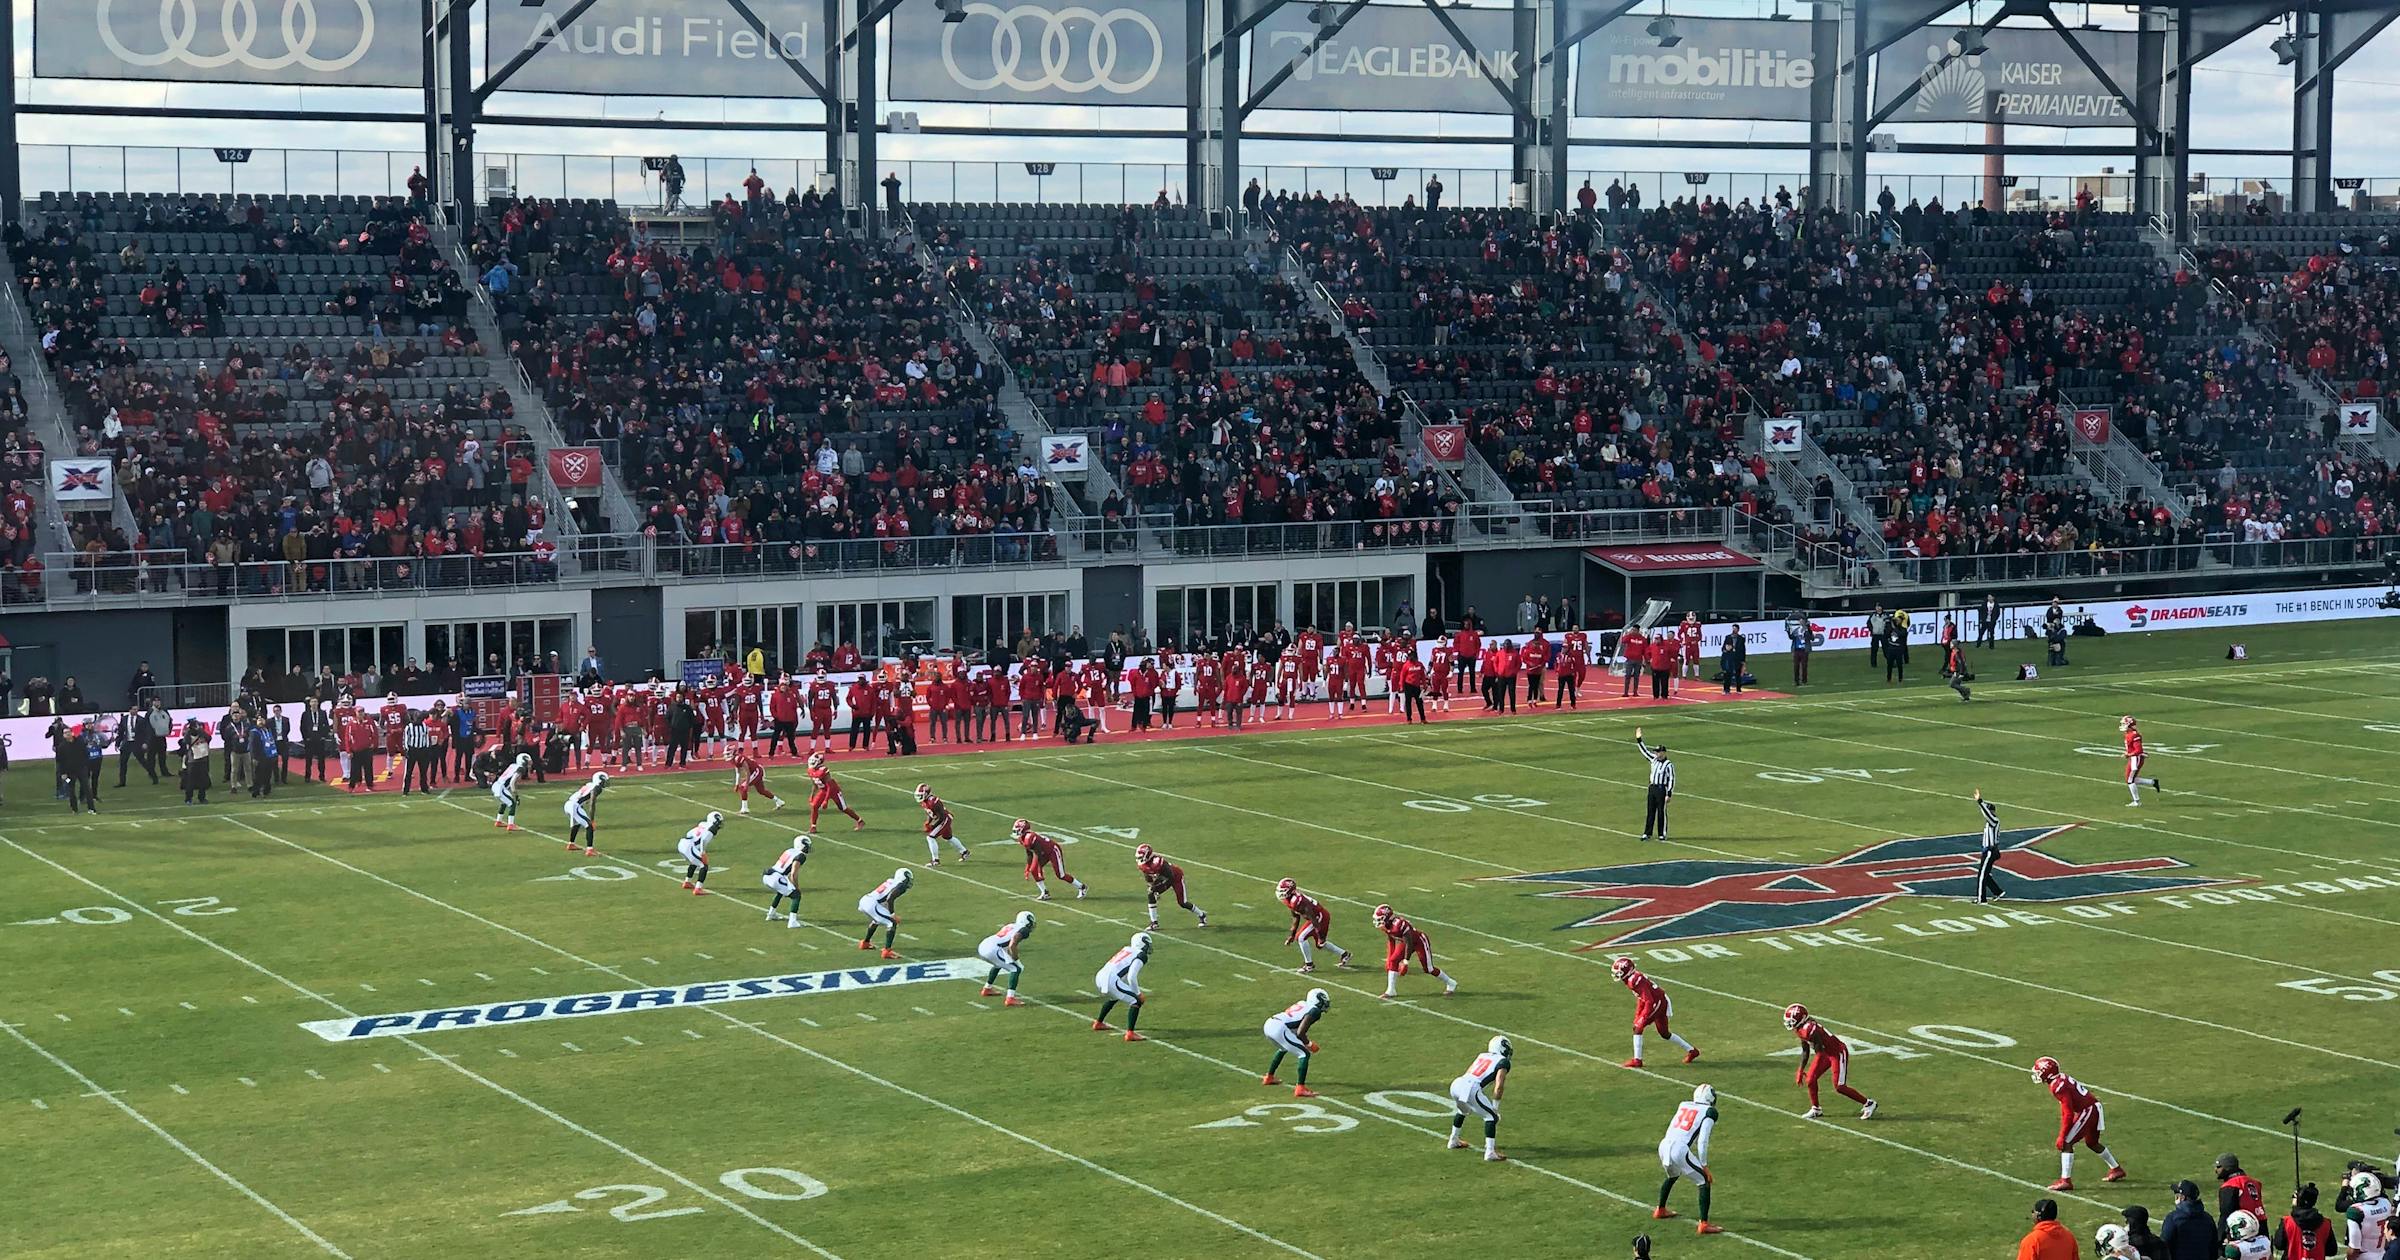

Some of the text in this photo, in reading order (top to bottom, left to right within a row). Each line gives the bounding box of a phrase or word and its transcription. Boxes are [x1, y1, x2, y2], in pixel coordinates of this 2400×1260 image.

[523, 11, 808, 61] Audi Field
[1608, 47, 1815, 89] mobilitie
[2000, 62, 2063, 86] KAISER
[222, 150, 244, 160] 126
[1032, 163, 1049, 173] 128
[1377, 169, 1392, 178] 129
[1690, 173, 1704, 183] 130
[2341, 180, 2358, 188] 132
[932, 487, 945, 499] 89
[2150, 604, 2248, 621] DRAGONSEATS
[2276, 602, 2294, 614] THE
[2296, 602, 2307, 613] #1
[2310, 599, 2342, 611] BENCH
[2344, 598, 2354, 610] IN
[2005, 616, 2040, 630] BENCH
[1686, 627, 1698, 638] 42
[845, 654, 853, 665] 12
[1434, 653, 1447, 664] 77
[1089, 669, 1100, 681] 12
[1203, 665, 1213, 677] 10
[1255, 670, 1267, 680] 24
[1329, 664, 1339, 675] 31
[388, 712, 402, 725] 56
[1402, 794, 1550, 813] 50
[1490, 826, 2250, 952] XFL
[60, 896, 239, 924] 20
[1748, 926, 1887, 951] THE
[1893, 908, 2055, 936] LOVE
[2061, 901, 2138, 920] OF
[2154, 871, 2400, 909] FOOTBAL
[2275, 969, 2400, 1001] 5
[347, 961, 951, 1038] PROGRESSIVE
[1244, 1090, 1457, 1133] 30
[574, 1167, 829, 1222] 20
